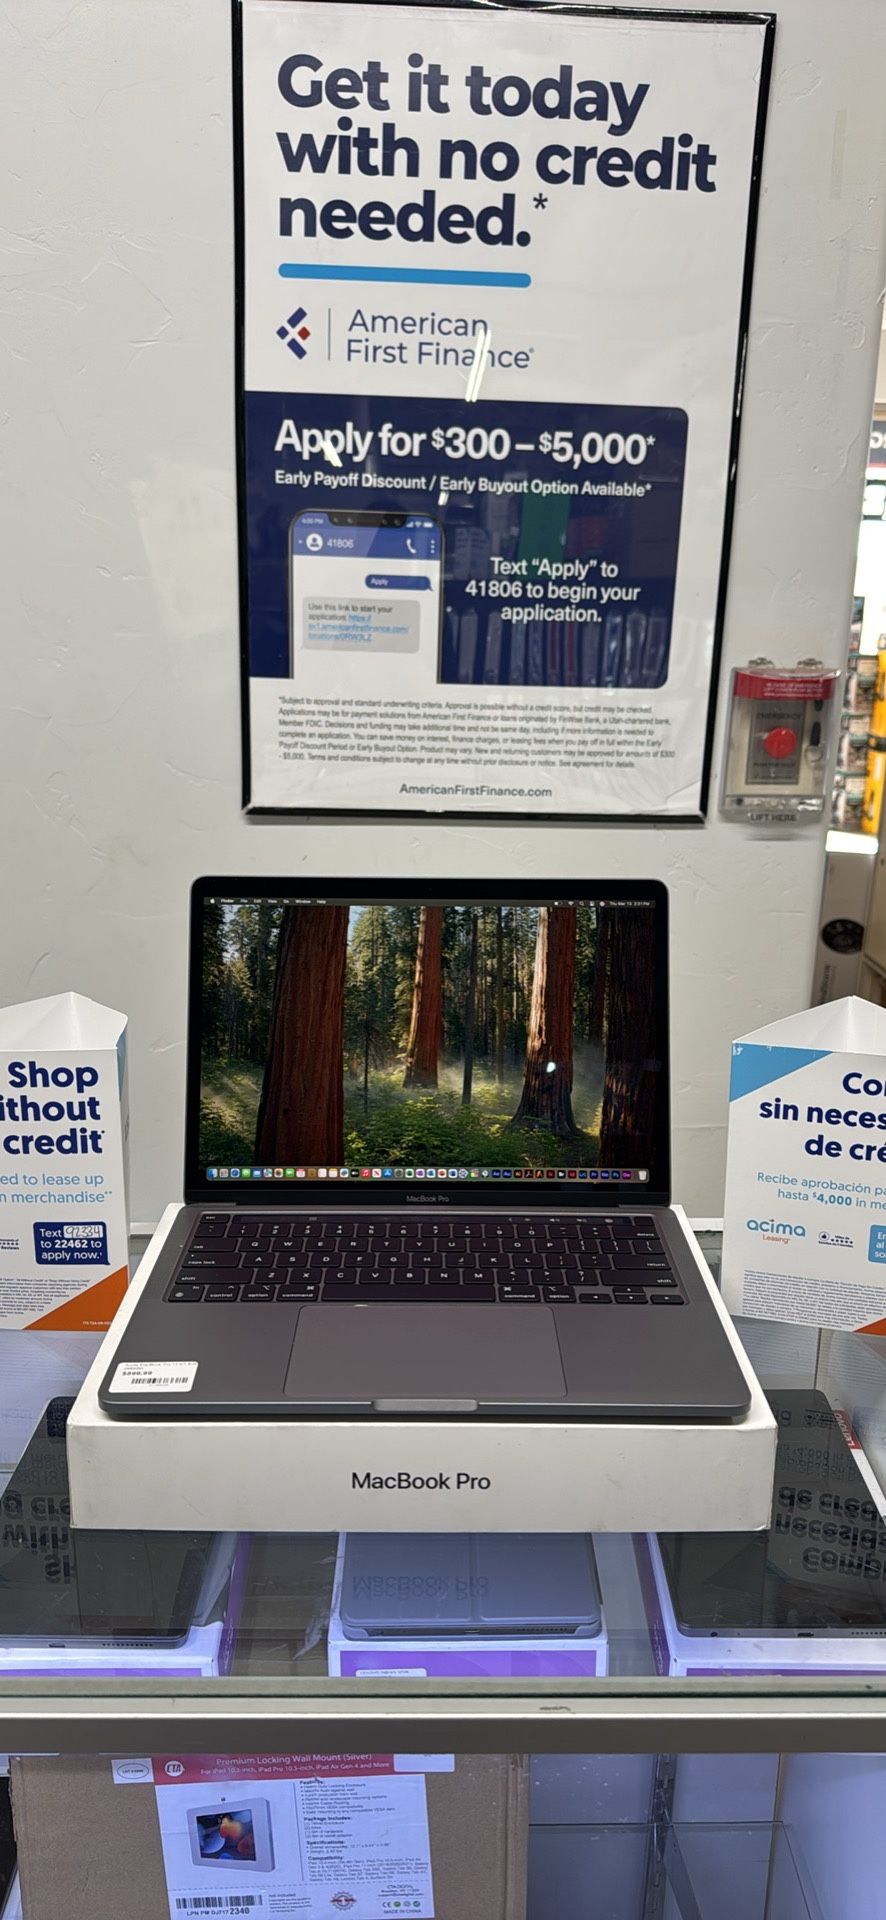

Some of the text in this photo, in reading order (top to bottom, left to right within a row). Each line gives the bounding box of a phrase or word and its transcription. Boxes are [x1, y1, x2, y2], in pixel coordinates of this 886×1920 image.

[278, 53, 650, 136] Get it today
[276, 117, 717, 192] with no credit
[349, 309, 488, 337] American
[347, 339, 408, 364] First
[274, 419, 373, 463] Apply
[378, 424, 426, 456] for
[431, 427, 510, 460] $300
[274, 470, 311, 486] Early
[314, 471, 358, 490] Payoff
[361, 472, 426, 490] Discount
[429, 475, 436, 490] /
[440, 476, 475, 493] Early
[478, 478, 528, 495] Buyout
[530, 480, 580, 497] Option
[327, 539, 354, 549] 41806
[490, 557, 618, 581] Text “Apply” to
[370, 578, 388, 587] Apply
[465, 580, 641, 604] 41806 to begin your
[501, 604, 602, 624] application.
[400, 784, 552, 798] AmericanFirstFinance.com
[751, 813, 796, 822] LIFT HERE
[8, 1061, 99, 1093] Shop
[842, 1072, 886, 1097] Co
[760, 1097, 886, 1130] sin neces
[805, 1134, 842, 1158] de
[23, 1174, 38, 1186] to
[42, 1173, 80, 1186] lease
[85, 1174, 104, 1188] up
[757, 1172, 798, 1186] Recibe
[801, 1175, 871, 1194] aprobación
[438, 1195, 449, 1203] Pro
[778, 1189, 809, 1201] hasta
[812, 1191, 852, 1207] $4,000
[856, 1197, 866, 1208] in
[40, 1228, 62, 1238] Text
[747, 1218, 806, 1237] acima
[40, 1240, 102, 1249] to 22462 to
[763, 1234, 788, 1244] Leasing
[41, 1250, 72, 1261] apply
[352, 1472, 491, 1490] MacBook Pro
[257, 1756, 290, 1765] Locking
[292, 1754, 311, 1762] Wall
[230, 1907, 250, 1915] 2340
